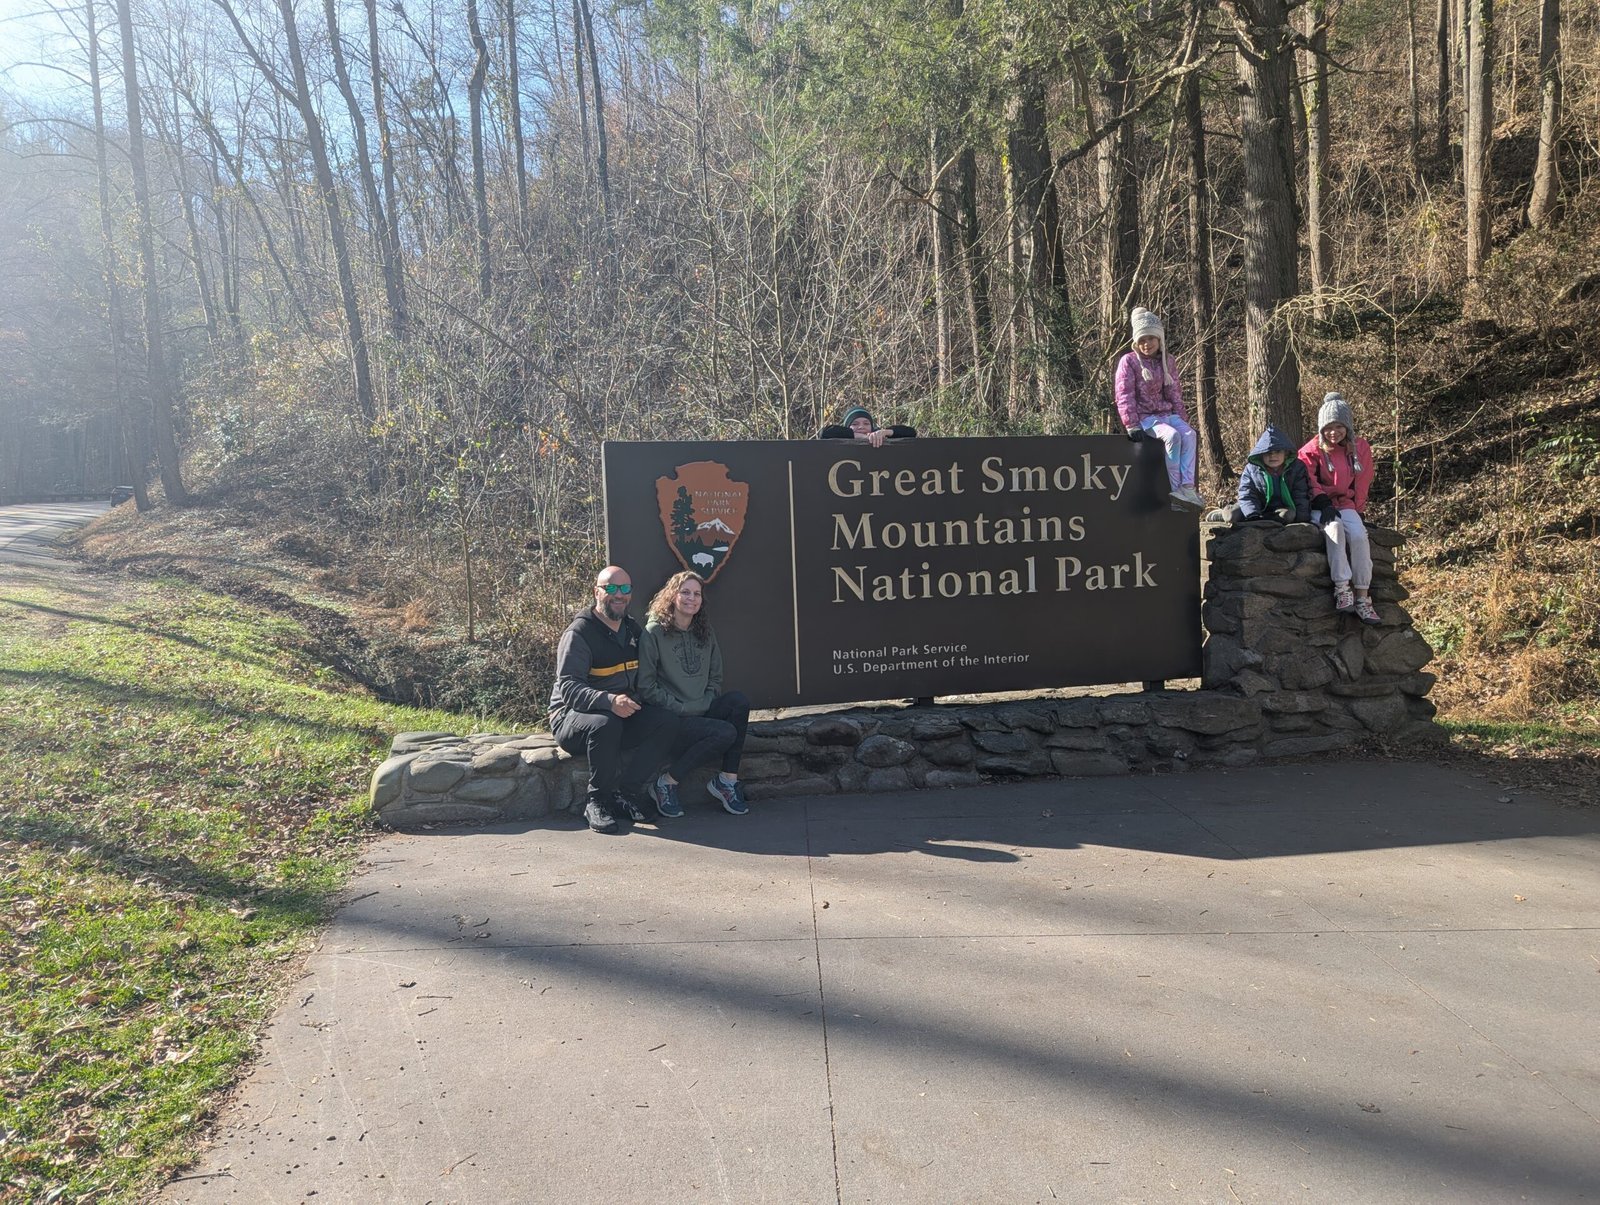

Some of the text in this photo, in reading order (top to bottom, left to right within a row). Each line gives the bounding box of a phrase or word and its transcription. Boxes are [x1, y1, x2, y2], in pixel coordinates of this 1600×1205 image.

[828, 453, 1132, 501] Great Smoky
[830, 506, 1086, 550] Mountains
[831, 552, 1159, 603] National Park
[832, 642, 968, 660] National Park Service
[833, 652, 1030, 675] U.S. Department of the Interior
